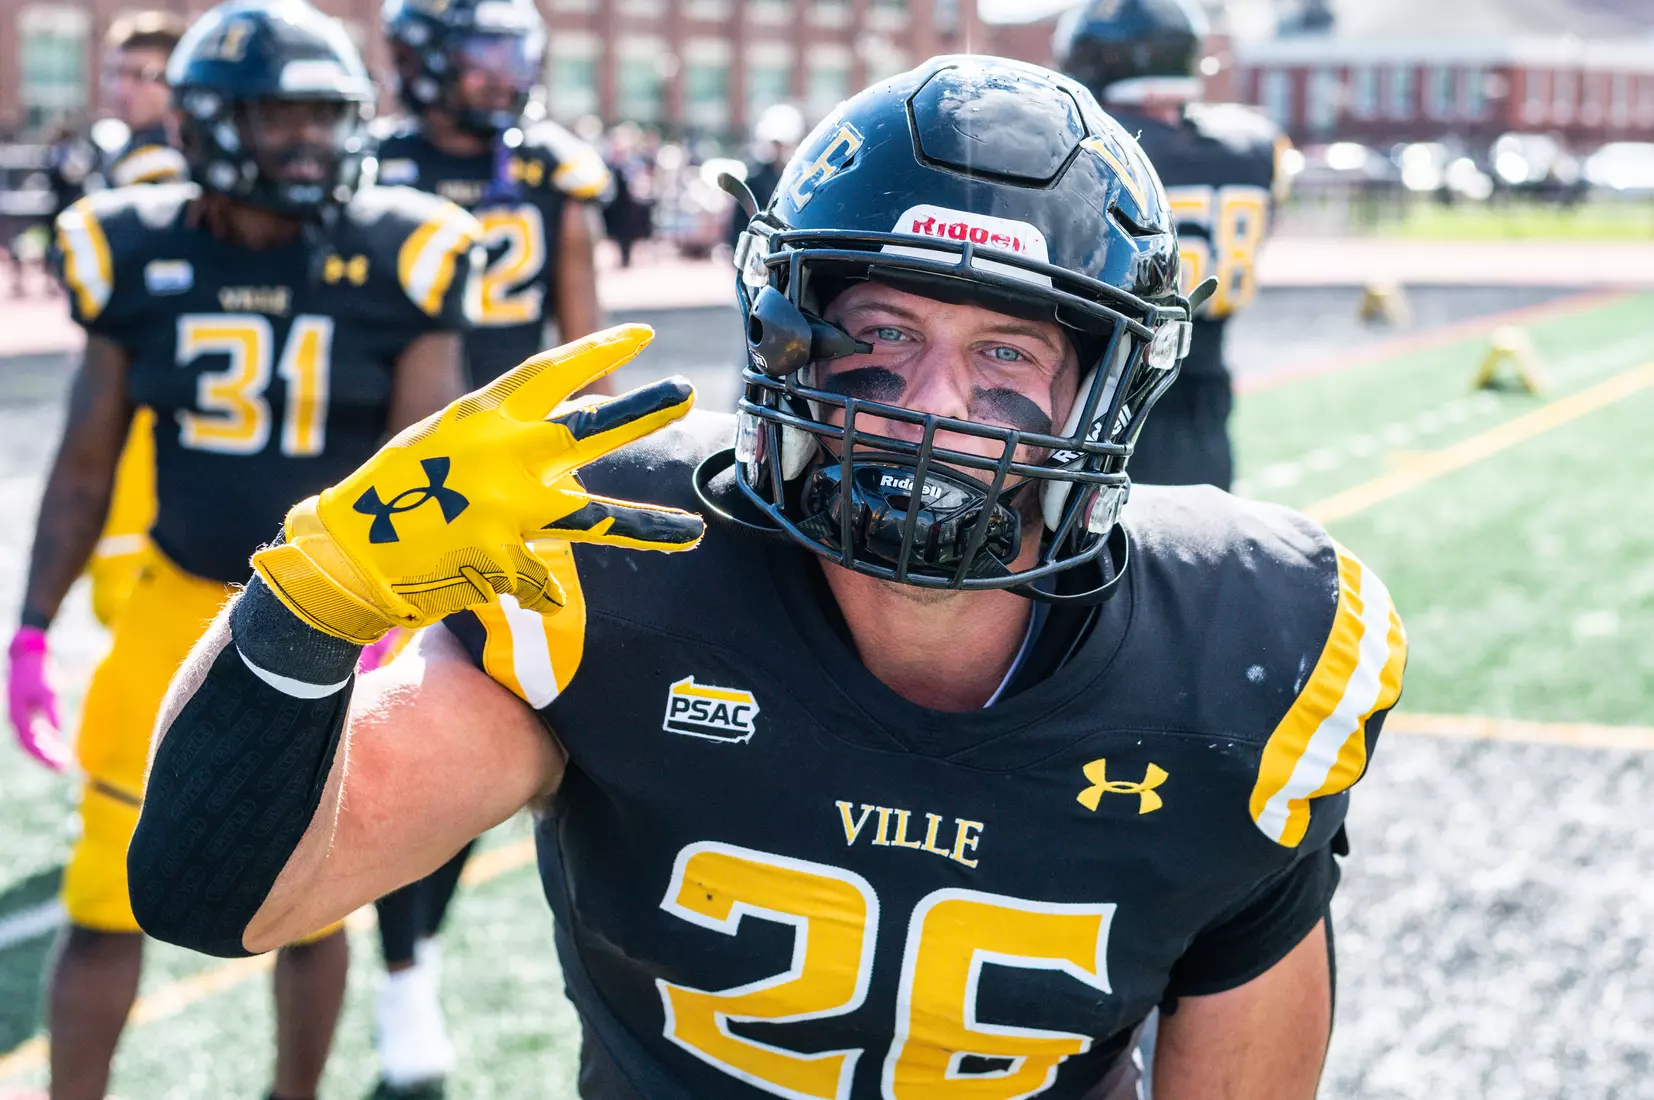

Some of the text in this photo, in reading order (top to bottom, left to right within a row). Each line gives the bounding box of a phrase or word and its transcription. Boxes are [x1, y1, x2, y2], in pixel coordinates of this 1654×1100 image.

[176, 313, 334, 456] 31
[670, 697, 751, 728] PSAC
[835, 800, 984, 869] VILLE
[655, 840, 1117, 1100] 26
